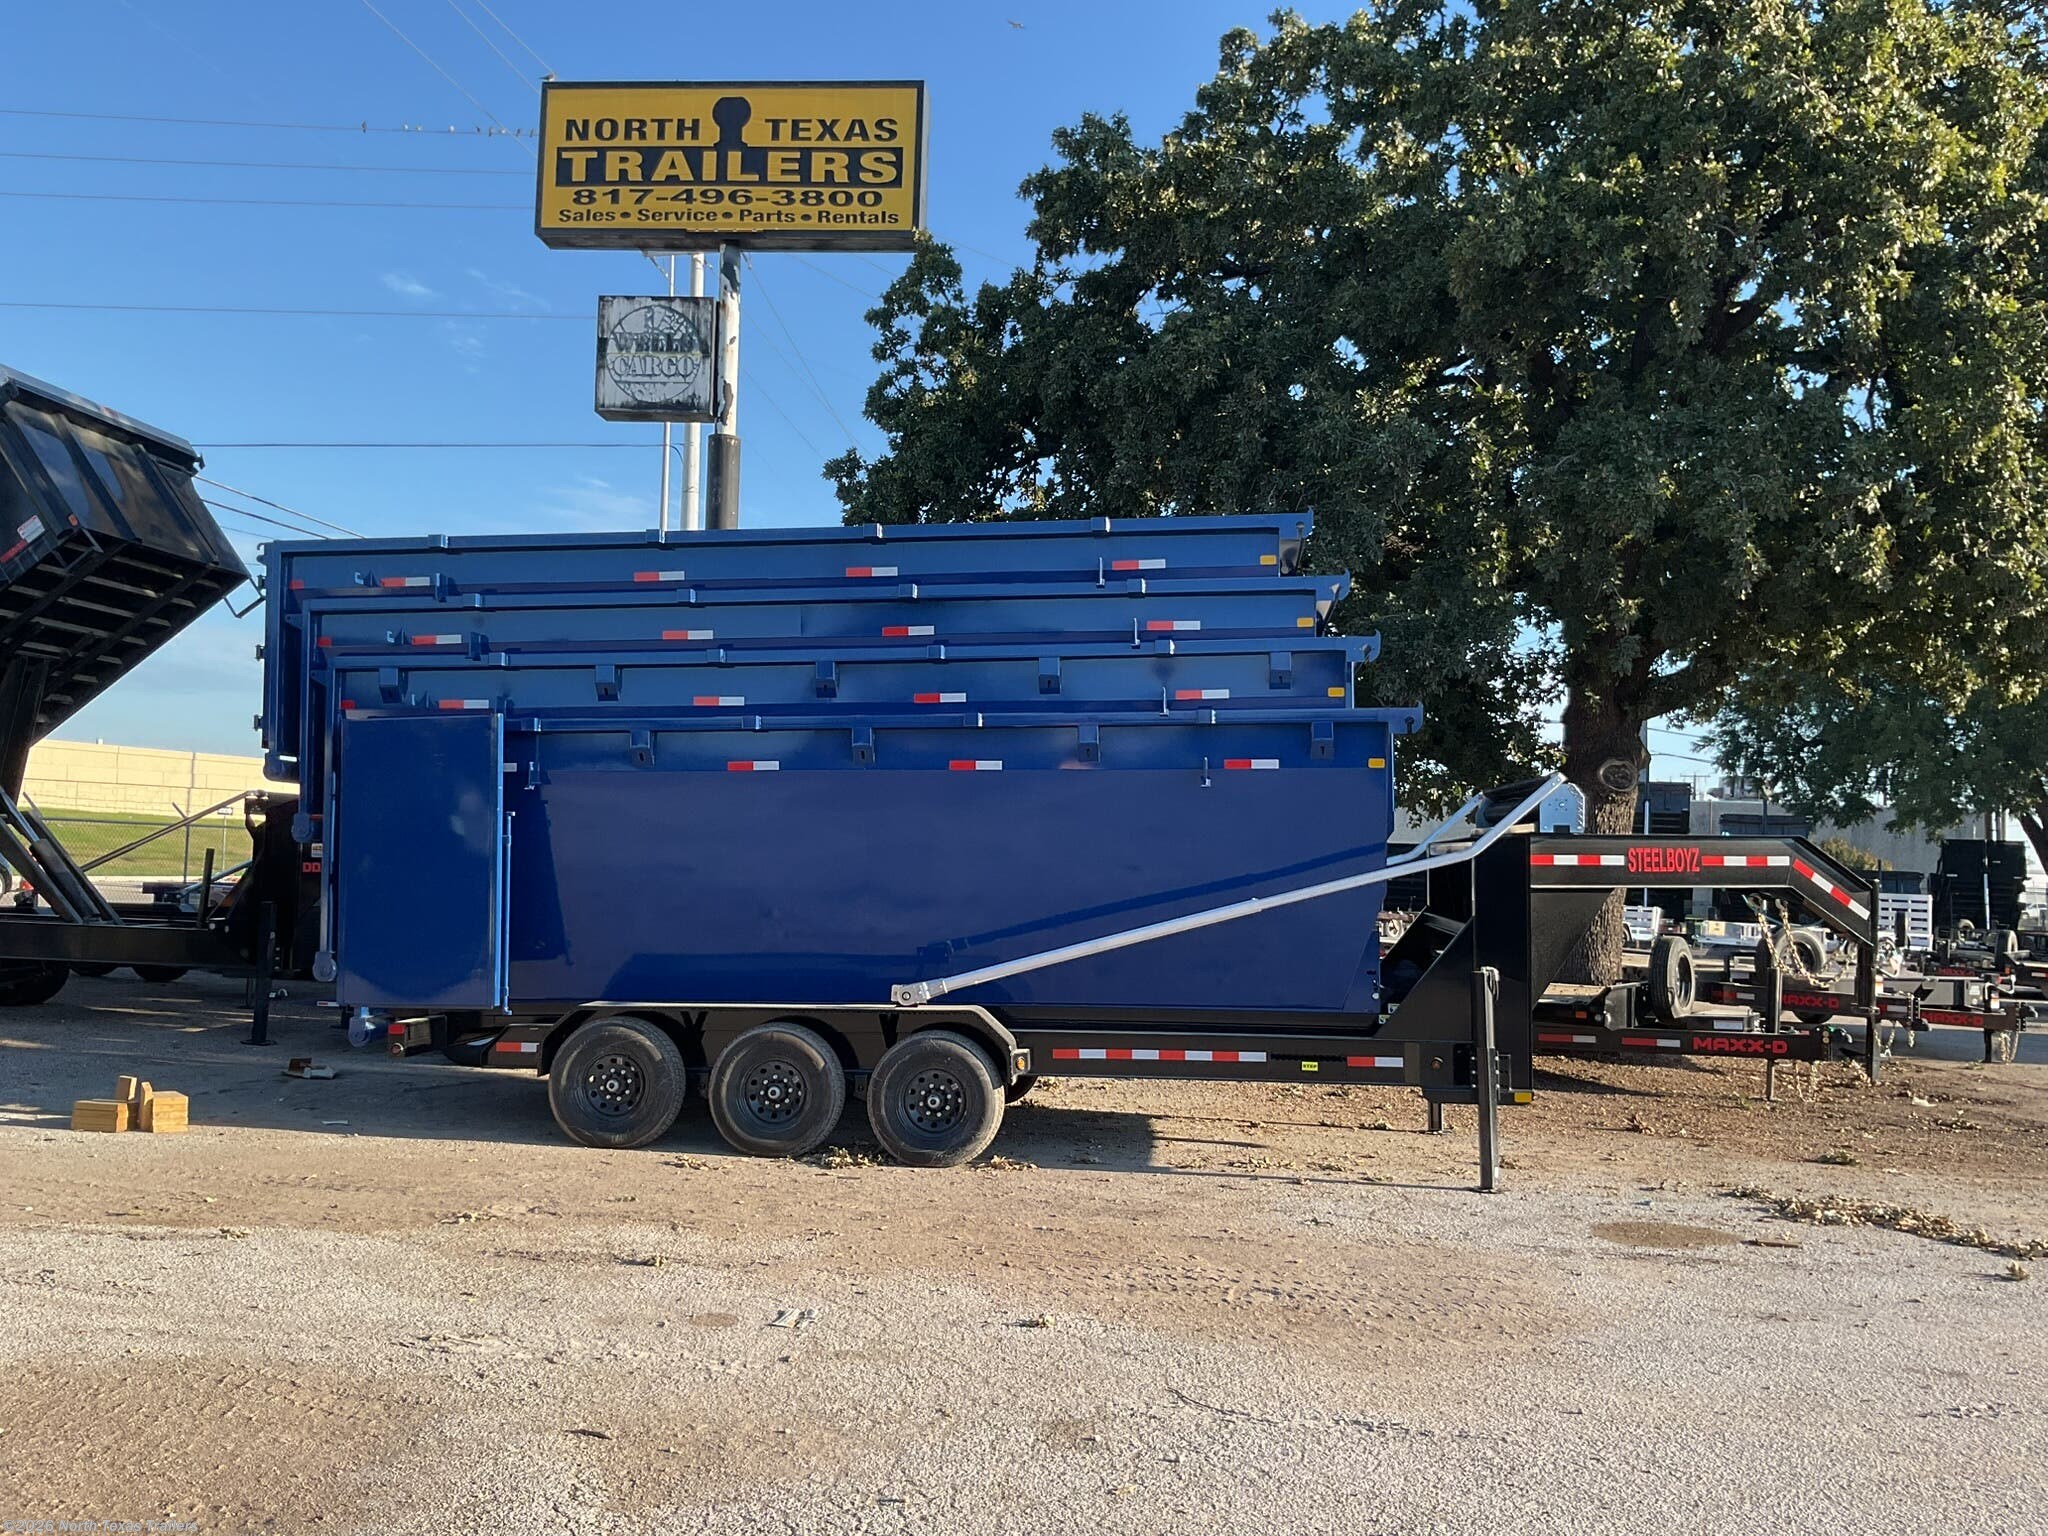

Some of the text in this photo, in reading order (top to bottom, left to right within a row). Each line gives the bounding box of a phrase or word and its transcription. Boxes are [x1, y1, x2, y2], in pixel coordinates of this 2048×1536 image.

[565, 118, 898, 142] NORTH TEXAS
[561, 151, 897, 184] TRAILERS
[572, 188, 883, 207] 817-496-3800
[558, 208, 899, 224] Sales Service Parts Rentals
[612, 354, 696, 378] CARGO
[1628, 847, 1700, 872] STEELBOYZ
[1692, 1036, 1788, 1054] MAXX-D
